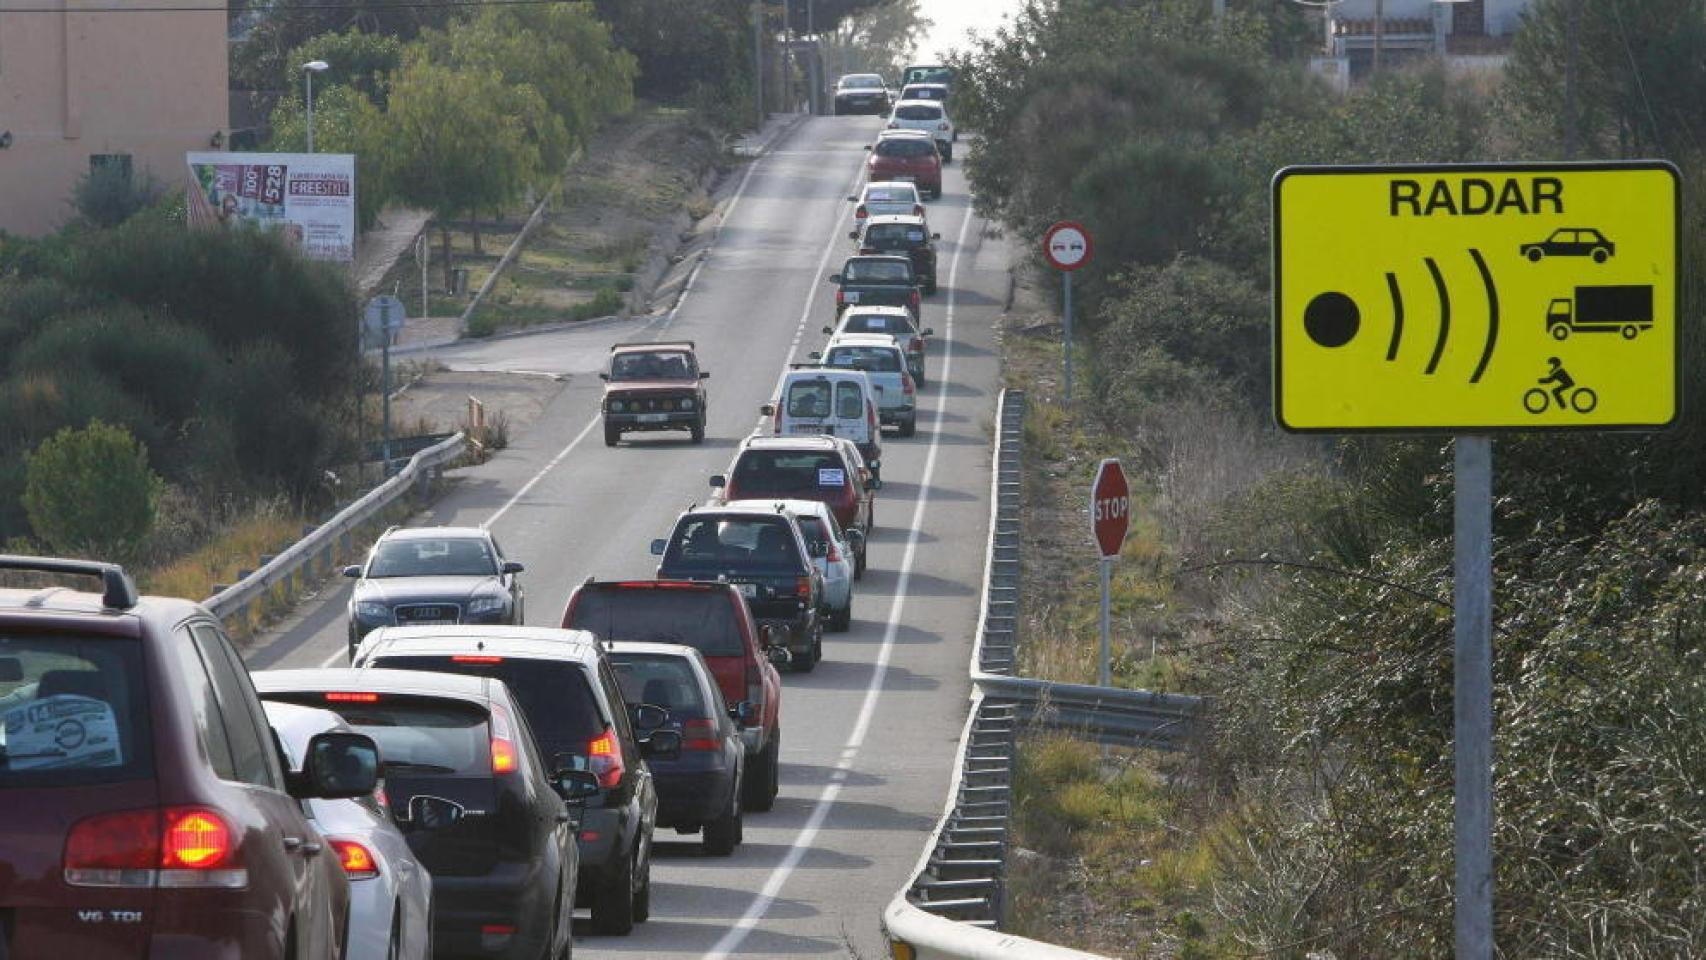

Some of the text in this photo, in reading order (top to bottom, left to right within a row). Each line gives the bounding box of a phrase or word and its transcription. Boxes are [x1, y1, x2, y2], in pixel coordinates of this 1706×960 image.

[1390, 177, 1564, 216] RADAR
[1096, 496, 1128, 520] STOP
[78, 910, 142, 922] V6 TDI
